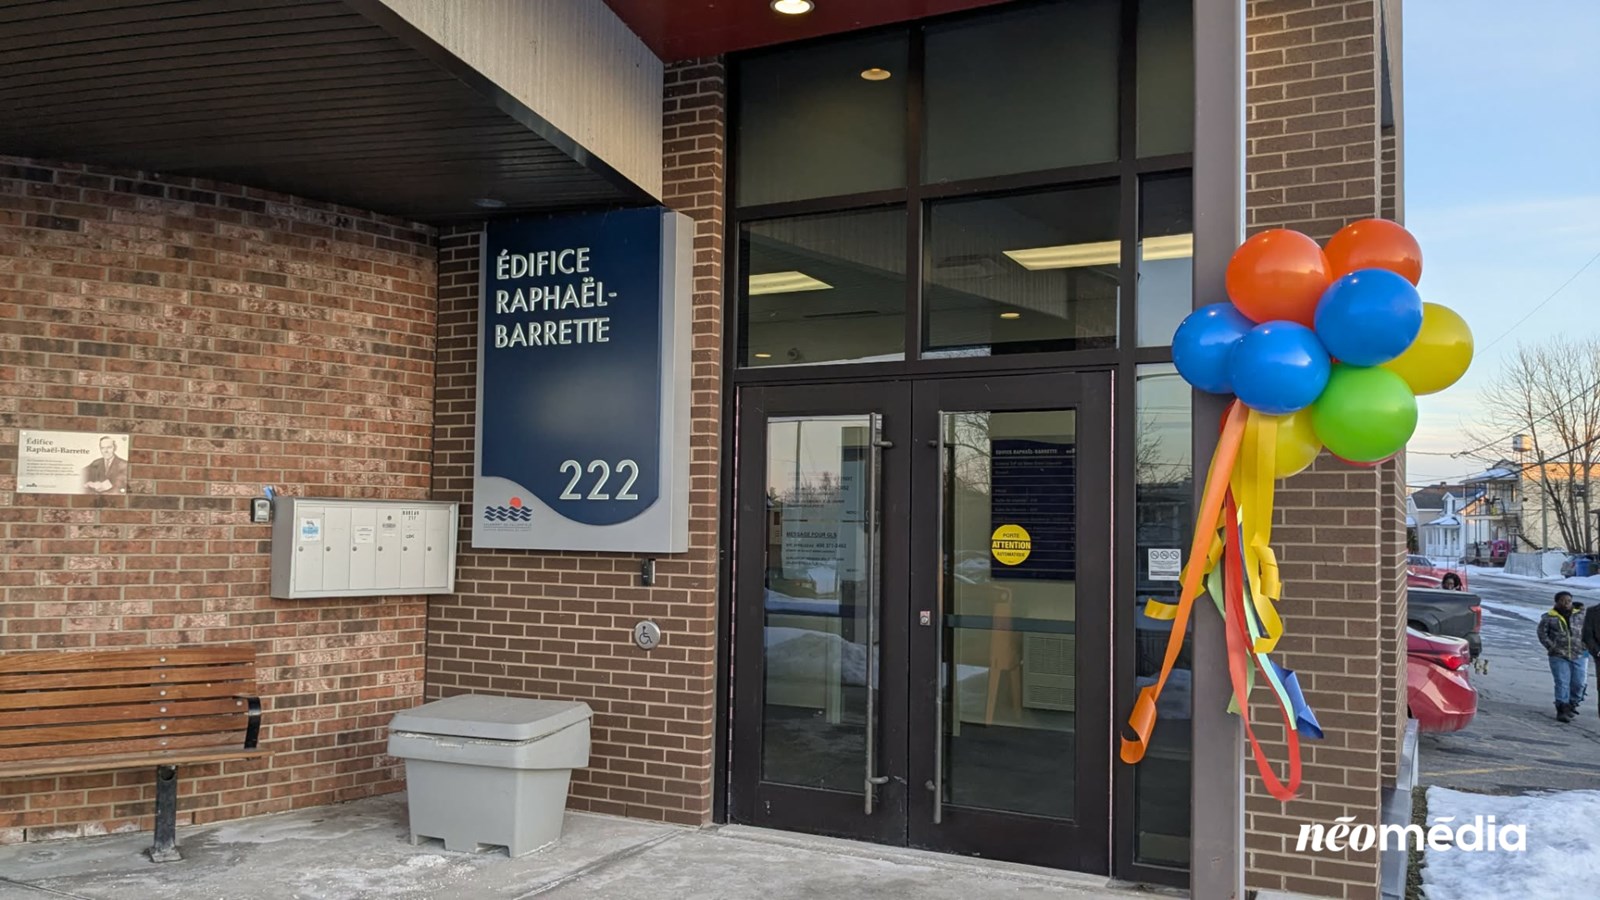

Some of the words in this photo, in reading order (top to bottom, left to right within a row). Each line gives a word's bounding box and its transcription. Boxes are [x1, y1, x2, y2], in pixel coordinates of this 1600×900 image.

[496, 247, 590, 280] ÉDIFICE
[496, 277, 618, 314] RAPHAËL-
[495, 317, 610, 348] BARRETTE
[26, 437, 54, 446] Édifice
[26, 445, 90, 455] Raphaël-Barrette
[559, 459, 639, 500] 222
[992, 541, 1031, 550] ATTENTION
